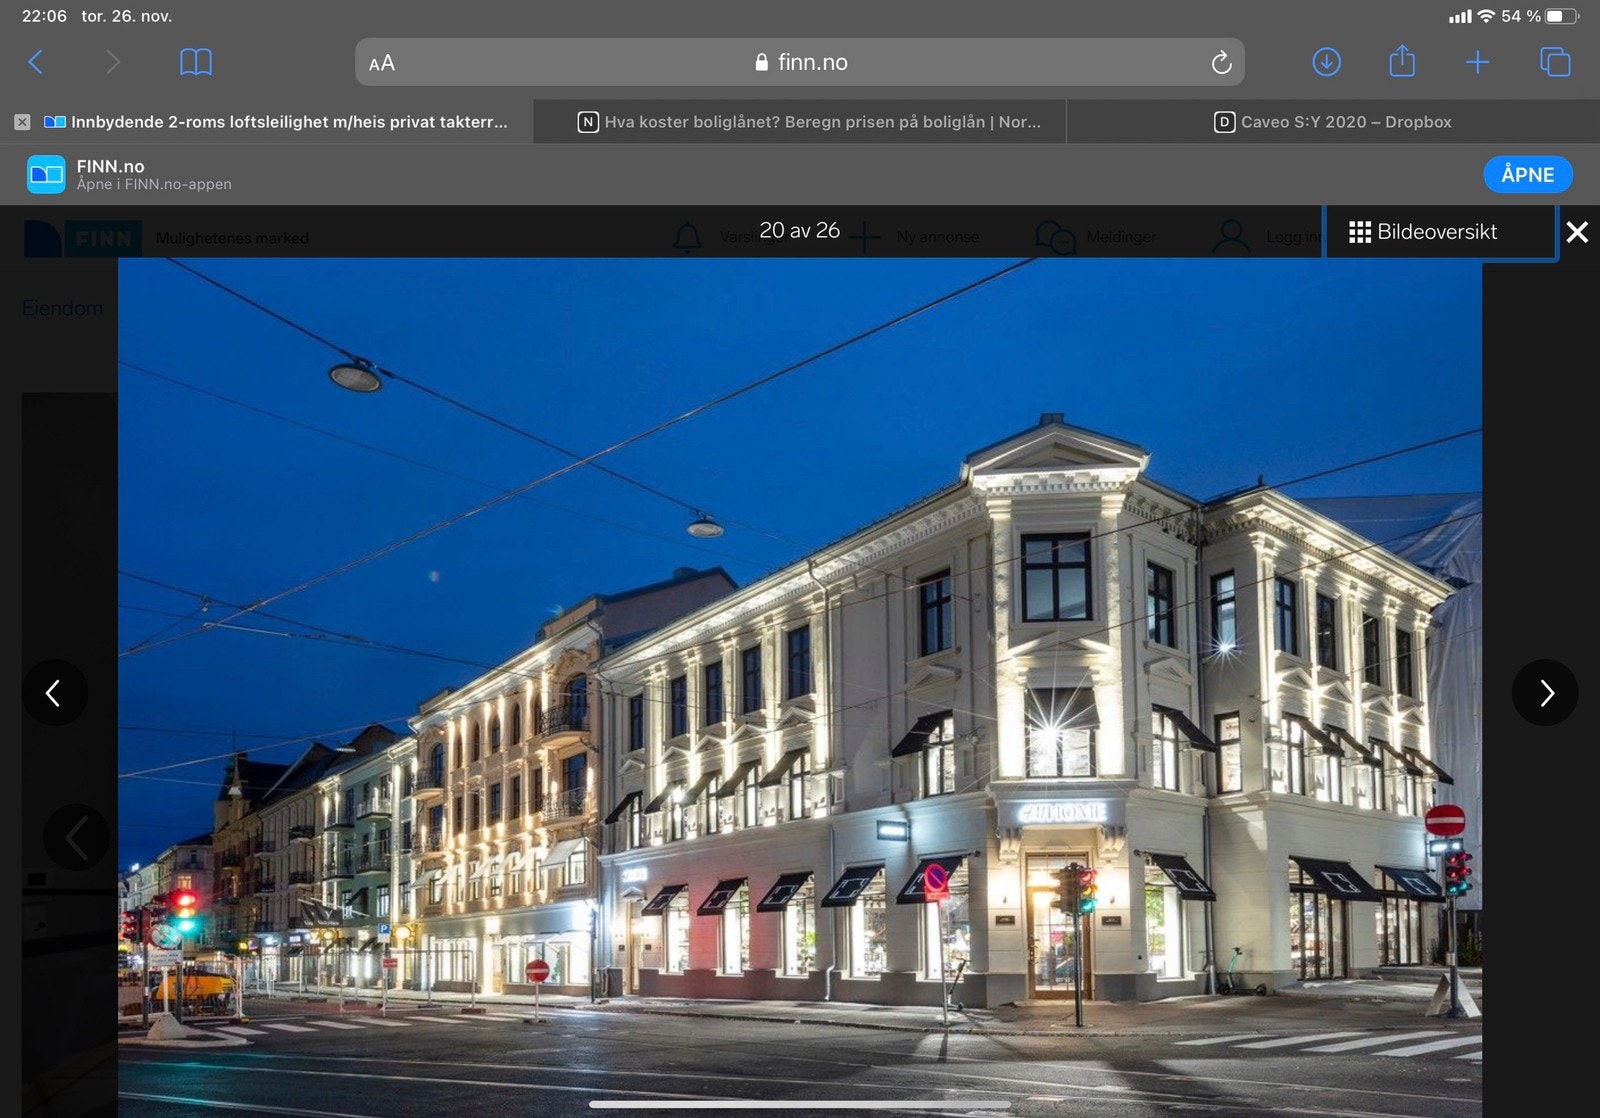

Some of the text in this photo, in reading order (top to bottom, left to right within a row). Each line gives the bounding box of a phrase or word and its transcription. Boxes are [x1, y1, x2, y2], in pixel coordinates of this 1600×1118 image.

[22, 10, 67, 22] 22:06
[81, 10, 172, 22] tor. 26. nov.
[1501, 10, 1542, 22] 54 %
[777, 52, 848, 71] finn.no
[71, 114, 164, 131] Innbydende
[168, 115, 226, 129] 2-roms
[230, 114, 329, 131] loftsleilighet
[333, 114, 386, 131] m/heis
[390, 114, 436, 131] privat
[605, 115, 635, 129] Hva
[639, 114, 690, 129] koster
[693, 114, 780, 131] boliglånet?
[785, 115, 841, 131] Beregn
[845, 114, 895, 131] prisen
[899, 113, 919, 131] på
[923, 113, 985, 131] boliglån
[1241, 115, 1290, 129] Caveo
[1294, 115, 1321, 129] S:Y
[1325, 115, 1367, 129] 2020
[1385, 115, 1452, 131] Dropbox
[77, 159, 145, 173] FINN.no
[1501, 162, 1555, 183] ÅPNE
[77, 175, 232, 192] Åpne i FINN.no-appen
[75, 231, 131, 246] FINN
[759, 221, 841, 239] 20 av 26
[896, 230, 980, 247] Ny annonse
[1087, 230, 1157, 247] Meldinger
[1266, 230, 1302, 246] Logg
[1378, 222, 1499, 241] Bildeoversikt
[155, 231, 310, 247] Mulighetenes marked
[22, 299, 104, 318] Eiendom
[380, 925, 388, 933] P
